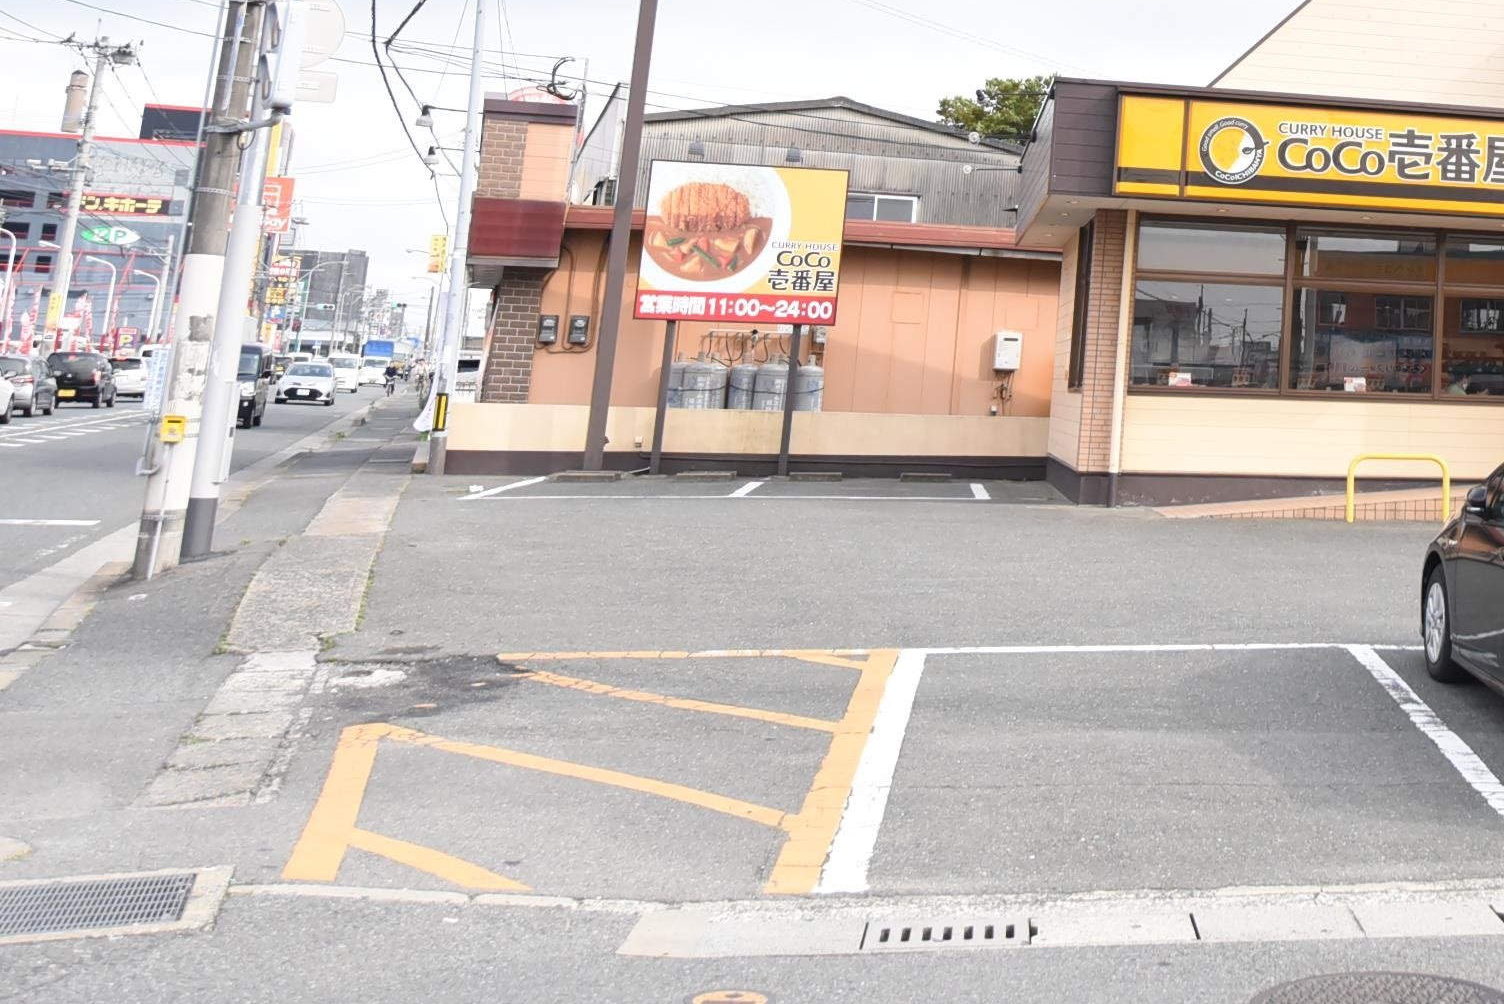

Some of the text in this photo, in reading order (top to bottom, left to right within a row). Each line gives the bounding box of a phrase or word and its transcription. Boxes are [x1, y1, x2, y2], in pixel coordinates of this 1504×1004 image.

[1278, 122, 1383, 140] CURRY HOUSE
[771, 241, 838, 252] CURRY HOUSE
[776, 250, 831, 269] CoCo
[768, 269, 835, 292] 壱番屋
